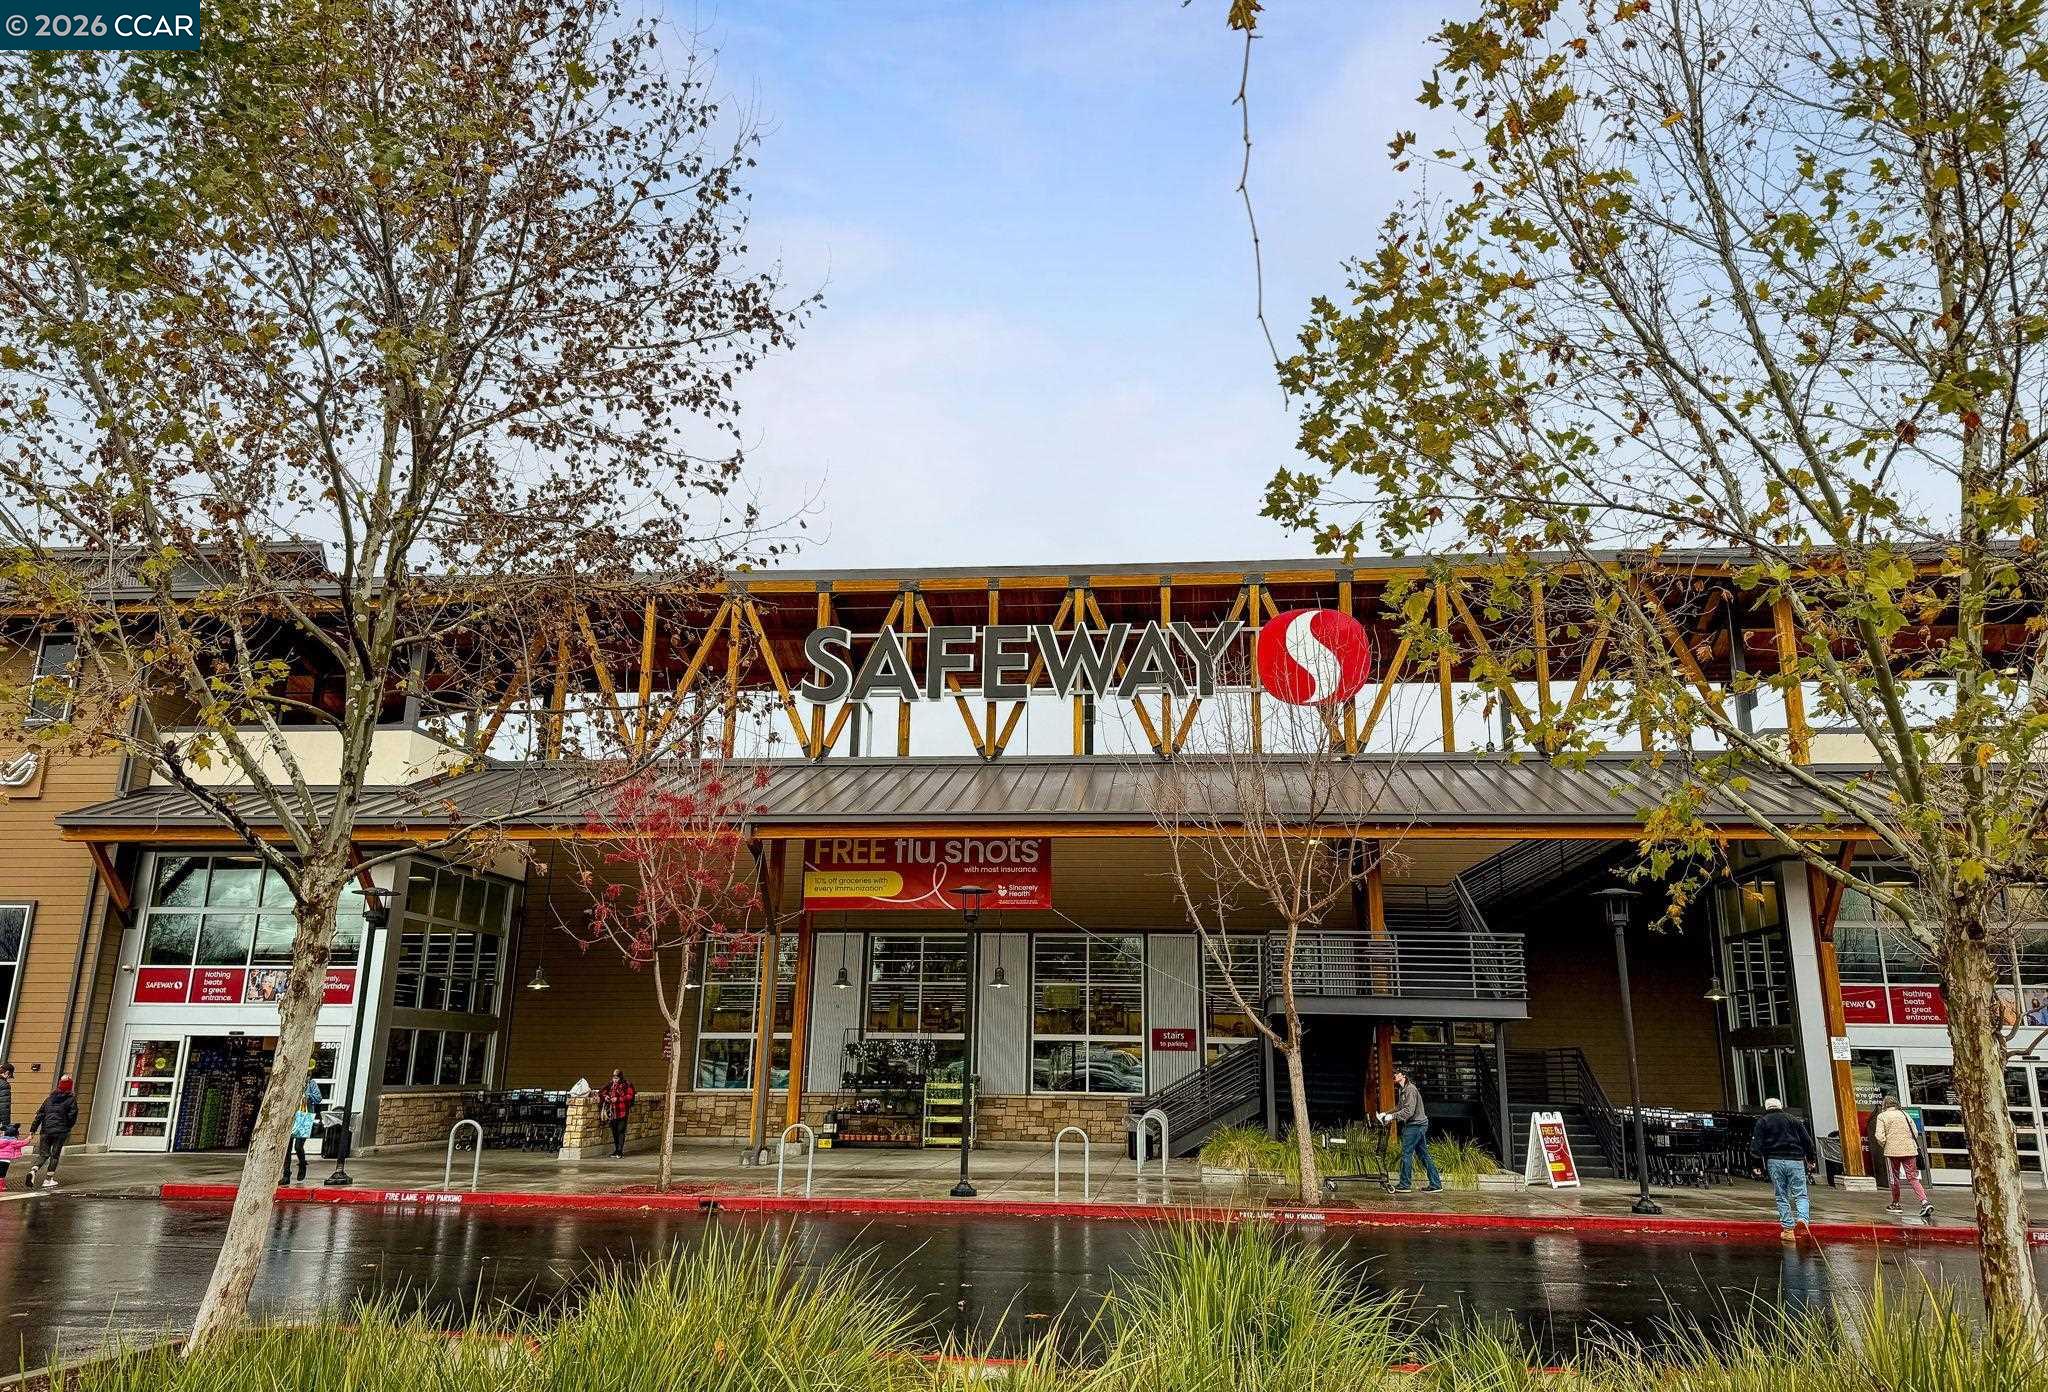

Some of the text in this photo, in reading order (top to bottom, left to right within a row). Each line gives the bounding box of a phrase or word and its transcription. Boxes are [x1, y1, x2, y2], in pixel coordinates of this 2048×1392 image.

[801, 620, 1244, 704] SAFEWAY
[814, 838, 886, 864] FREE
[895, 838, 935, 864] flu
[1008, 884, 1039, 892] Sincerely
[204, 971, 231, 979] Nothing
[145, 981, 174, 989] SAFEWAY
[1903, 990, 1932, 999] Nothing
[1911, 1006, 1932, 1014] great
[1162, 1031, 1185, 1040] stairs
[1167, 1041, 1189, 1049] parking
[385, 1192, 400, 1201] FIRE
[401, 1193, 418, 1201] LANE
[425, 1193, 435, 1201] NO
[436, 1194, 462, 1202] PARKING
